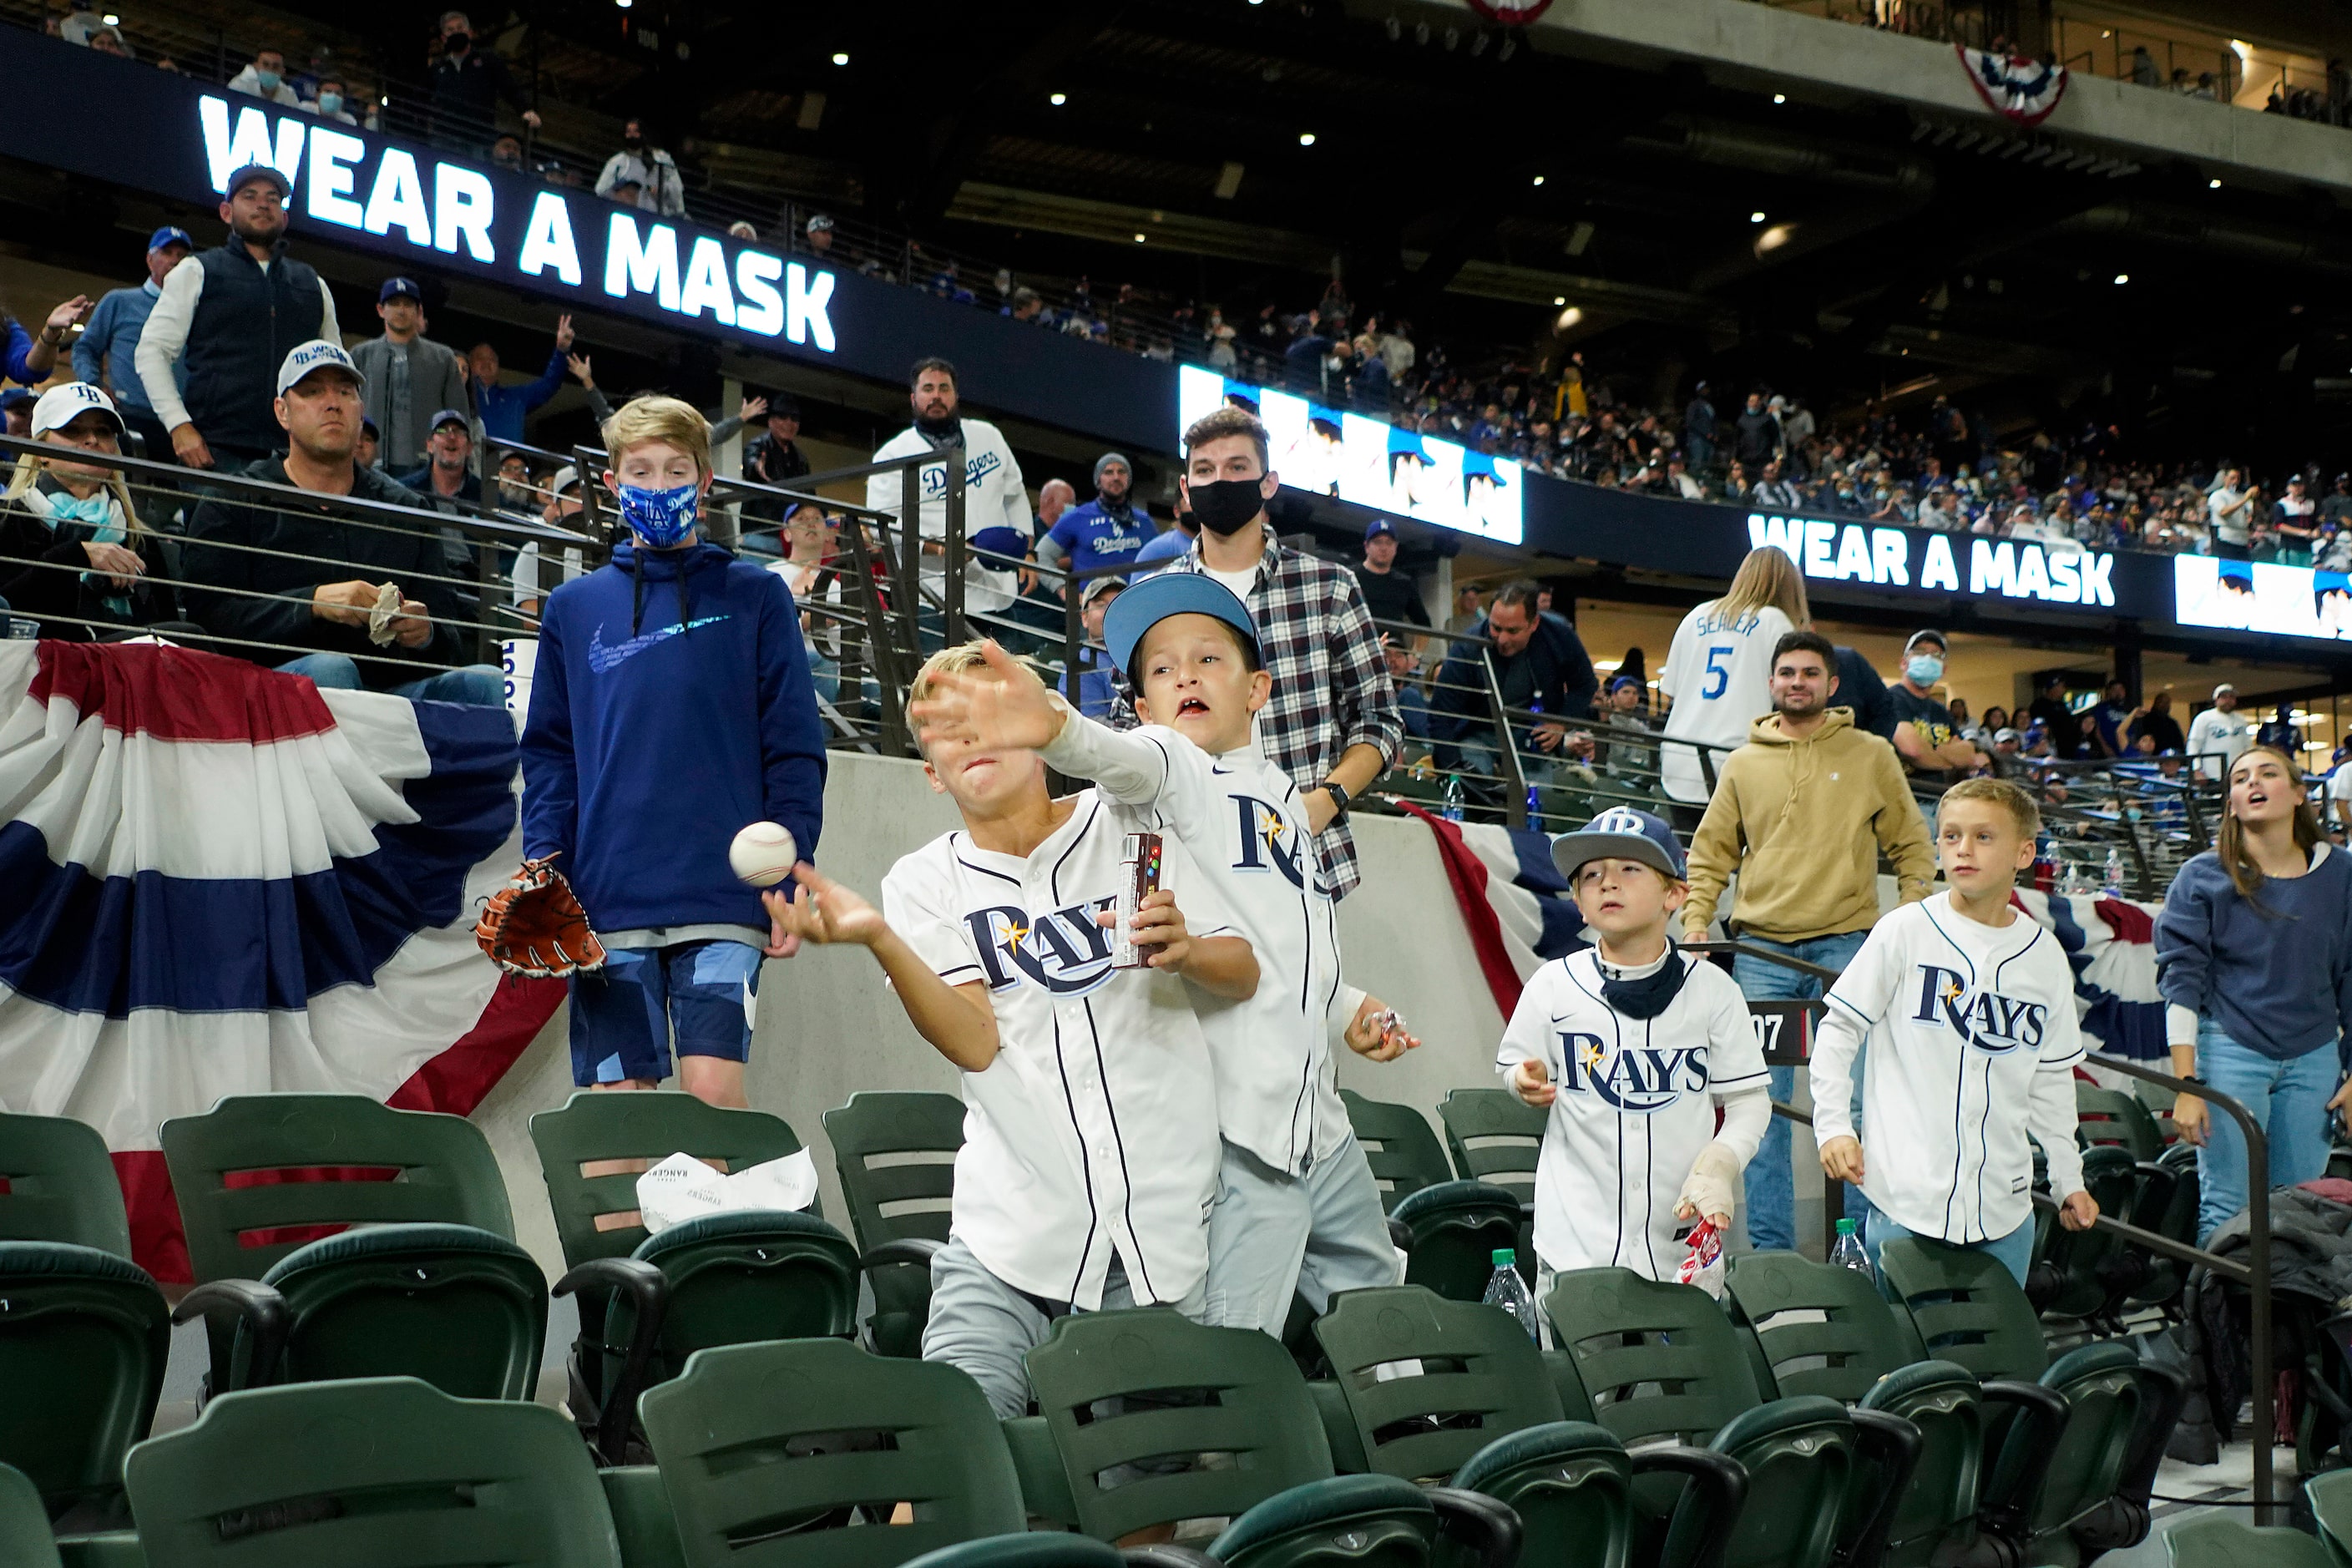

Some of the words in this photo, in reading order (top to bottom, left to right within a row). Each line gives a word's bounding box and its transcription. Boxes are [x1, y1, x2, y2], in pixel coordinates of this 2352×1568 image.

[199, 94, 495, 265] WEAR
[518, 190, 582, 286] A
[604, 212, 836, 353] MASK
[69, 386, 101, 402] TB
[923, 452, 1000, 493] Dgers
[1093, 535, 1142, 554] Dodgers
[1747, 514, 1909, 586] WEAR
[1920, 534, 1959, 591] A
[1970, 539, 2115, 607] MASK
[1702, 647, 1734, 700] 5
[963, 894, 1118, 995] RAY
[1911, 964, 2047, 1055] RAYS
[1556, 1030, 1709, 1113] RAYS
[650, 1169, 688, 1178] RANGER
